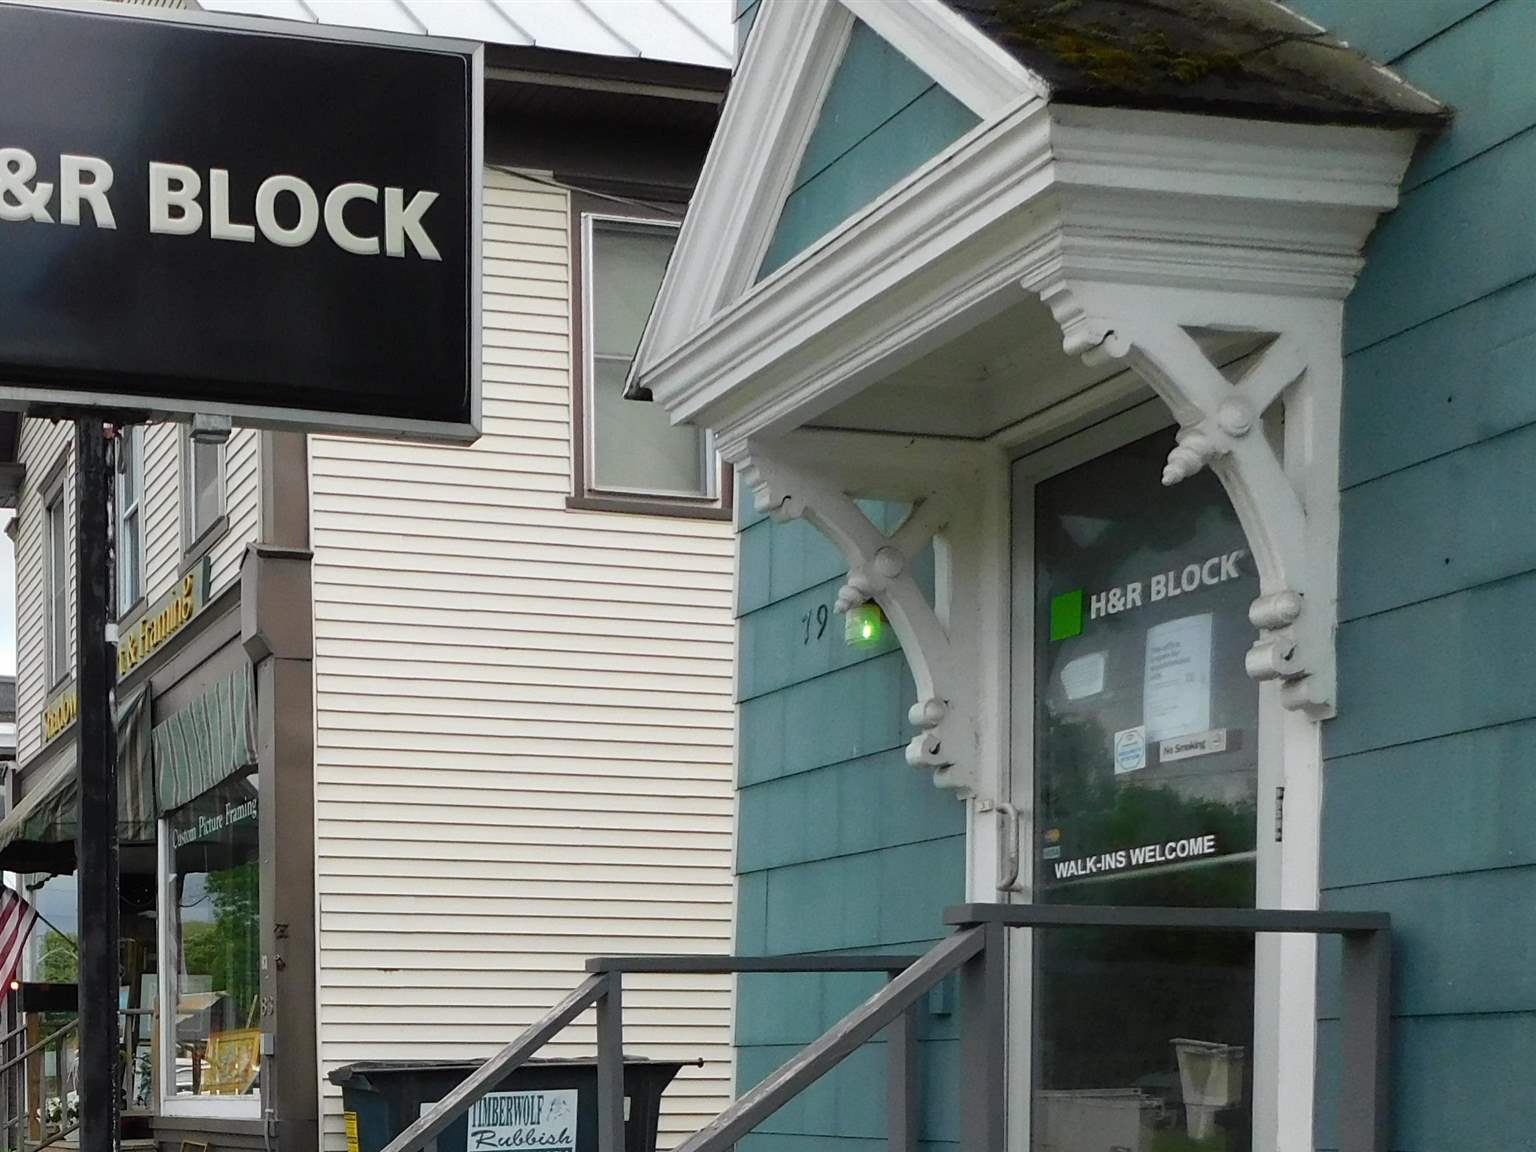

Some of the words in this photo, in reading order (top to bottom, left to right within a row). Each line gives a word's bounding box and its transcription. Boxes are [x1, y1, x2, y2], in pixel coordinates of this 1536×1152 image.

[148, 160, 444, 262] BLOCK
[1090, 581, 1143, 620] H&R
[1150, 550, 1242, 602] BLOCK
[1175, 739, 1206, 752] Smoking
[172, 827, 197, 849] Custom
[198, 814, 224, 838] Picture
[225, 796, 257, 825] Framing
[1055, 850, 1126, 879] WALK-INS
[1129, 835, 1215, 866] WELCOME
[471, 1127, 573, 1149] Rubbish
